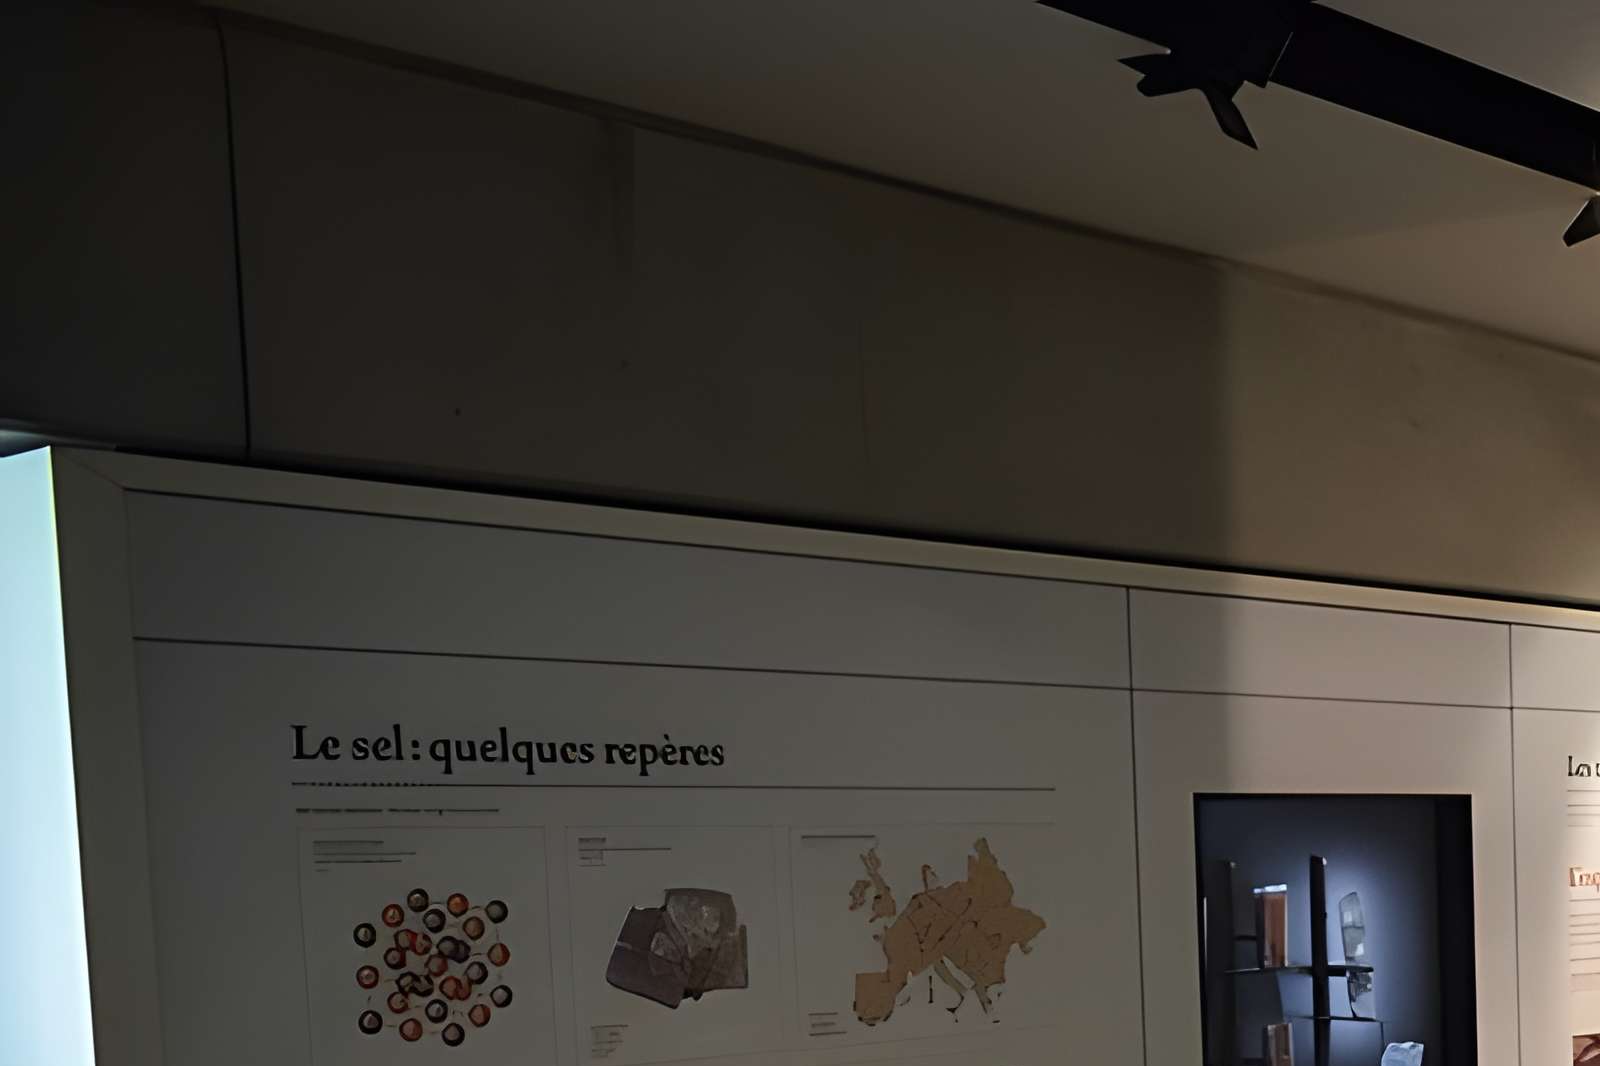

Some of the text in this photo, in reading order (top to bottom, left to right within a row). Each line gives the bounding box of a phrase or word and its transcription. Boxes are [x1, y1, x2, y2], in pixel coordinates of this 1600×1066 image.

[290, 724, 341, 760] Le
[429, 726, 595, 775] quelques
[604, 733, 725, 776] repères
